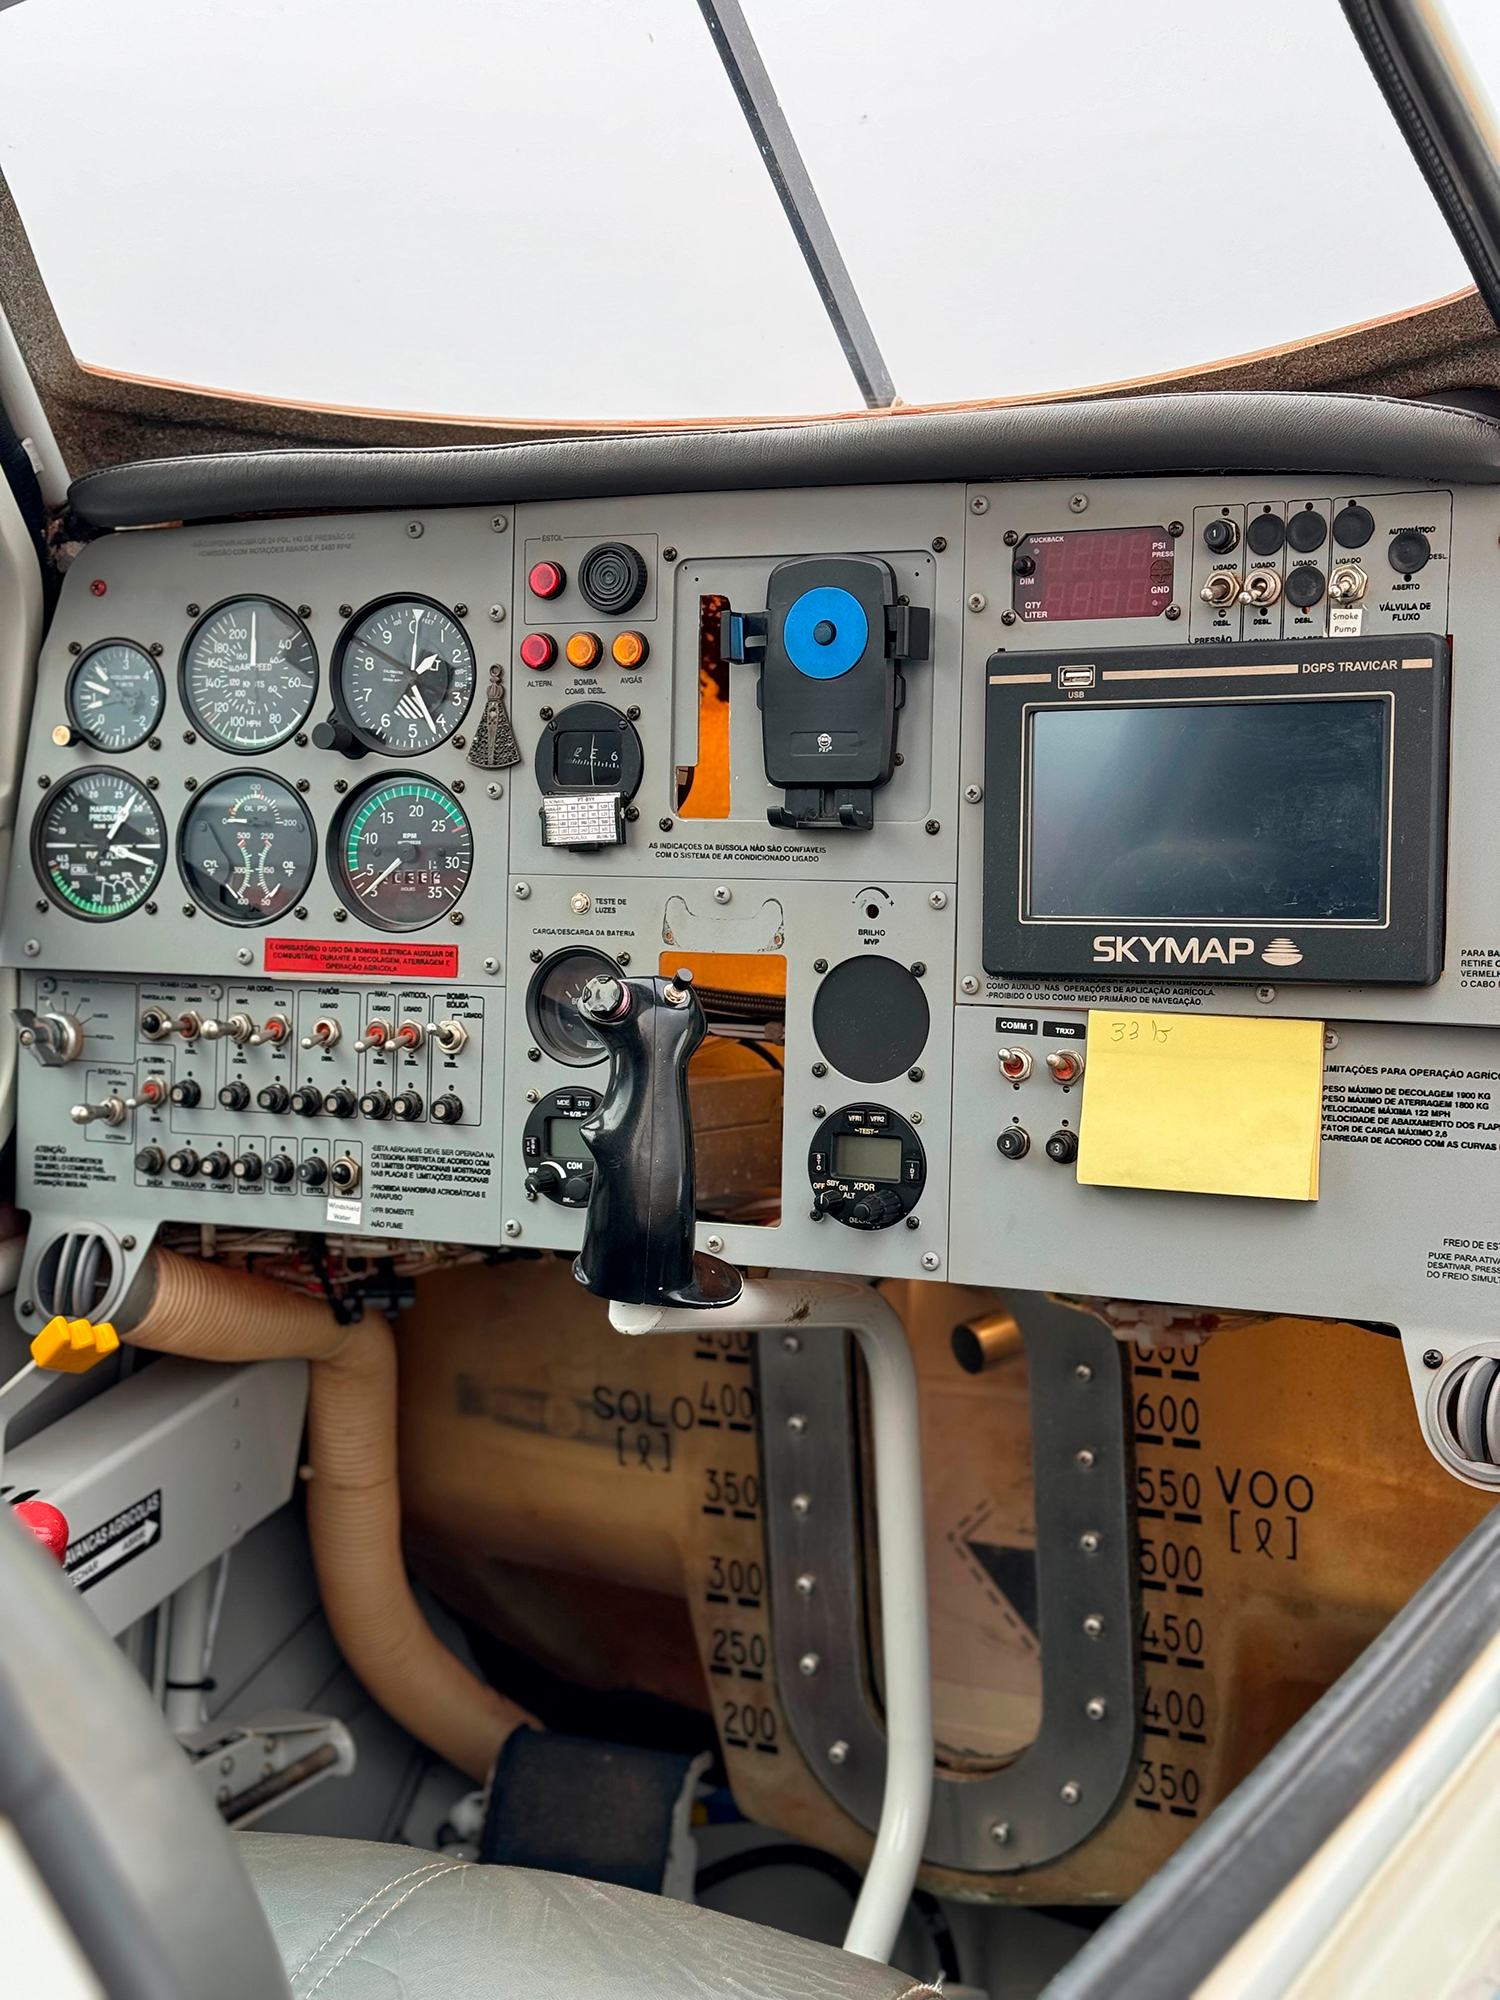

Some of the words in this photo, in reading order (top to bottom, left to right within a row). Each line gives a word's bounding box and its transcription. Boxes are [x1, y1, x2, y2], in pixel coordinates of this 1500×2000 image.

[542, 534, 563, 543] ESTOL
[1029, 536, 1064, 544] SUCKBACK
[1152, 542, 1166, 550] PSI
[1151, 586, 1169, 594] GND
[1392, 583, 1420, 591] ABERTO
[1025, 601, 1041, 609] QTY
[1379, 603, 1417, 611] VÁLVULA
[1420, 602, 1431, 610] DE
[1333, 612, 1358, 621] Smoke
[1393, 612, 1420, 621] FLUXO
[229, 629, 247, 640] 200
[1335, 625, 1357, 634] Pump
[382, 630, 392, 644] 9
[214, 643, 229, 653] 180
[278, 639, 292, 650] 40
[452, 649, 462, 663] 2
[207, 658, 222, 668] 160
[364, 657, 374, 671] 8
[1302, 663, 1335, 674] DGPS
[1338, 660, 1398, 672] TRAVICAR
[205, 678, 221, 688] 140
[288, 677, 301, 688] 60
[527, 680, 553, 688] ALTERN.
[620, 676, 643, 684] AVGÁS
[362, 688, 373, 702] 7
[452, 692, 462, 706] 3
[1068, 691, 1084, 699] USB
[214, 702, 229, 713] 120
[230, 716, 245, 727] 100
[246, 720, 262, 728] MPH
[269, 713, 281, 724] 80
[380, 713, 391, 728] 6
[436, 713, 446, 727] 4
[408, 724, 418, 738] 5
[611, 752, 618, 761] 6
[409, 805, 424, 817] 20
[283, 819, 297, 827] 200
[380, 812, 394, 824] 15
[431, 820, 446, 832] 25
[237, 832, 250, 840] 500
[365, 833, 378, 844] 10
[445, 856, 459, 868] 30
[734, 853, 791, 861] CONDICIONADO
[366, 864, 374, 876] 5
[428, 886, 442, 898] 35
[617, 898, 627, 906] DE
[532, 928, 594, 936] CARGA/DESCARGA
[858, 928, 885, 936] BRILHO
[1092, 936, 1255, 964] SKYMAP
[1461, 949, 1485, 957] PARA
[986, 982, 1009, 990] COMO
[1125, 986, 1170, 996] APLICAÇÃO
[1460, 980, 1468, 988] O
[1470, 980, 1496, 988] CABO
[1001, 1021, 1027, 1030] COMM
[1029, 1022, 1034, 1030] 1
[1055, 1026, 1075, 1035] TRXD
[1381, 1067, 1407, 1075] PARA
[1409, 1068, 1464, 1079] OPERAÇÃO
[1348, 1085, 1383, 1095] MÁXIMO
[1399, 1088, 1453, 1098] DECOLAGEM
[1477, 1092, 1491, 1100] KG
[1348, 1095, 1382, 1104] MÁXIMO
[1397, 1098, 1452, 1108] ATERRAGEM
[1455, 1101, 1475, 1109] 1800
[1476, 1102, 1489, 1110] KG
[1322, 1105, 1375, 1114] VELOCIDADE
[1378, 1106, 1412, 1116] MÁXIMA
[1414, 1109, 1429, 1117] 122
[1005, 1140, 1010, 1148] 3
[1054, 1144, 1060, 1152] 3
[567, 1162, 582, 1170] COM
[853, 1182, 875, 1191] XPDR
[1443, 1238, 1470, 1248] FREIO
[1472, 1240, 1484, 1249] DE
[1428, 1252, 1452, 1260] PUXE
[1454, 1253, 1478, 1262] PARA
[1427, 1261, 1473, 1272] DESATIVAR,
[700, 1381, 754, 1419] 400
[592, 1385, 694, 1431] SOLO
[1137, 1393, 1199, 1434] 600
[705, 1469, 758, 1507] 350
[1138, 1467, 1200, 1509] 550
[1216, 1465, 1313, 1512] VOO
[1140, 1539, 1202, 1581] 500
[709, 1557, 762, 1596] 300
[1140, 1612, 1203, 1653] 450
[713, 1629, 765, 1668] 250
[1142, 1687, 1204, 1728] 400
[724, 1701, 776, 1741] 200
[1138, 1761, 1199, 1804] 350
